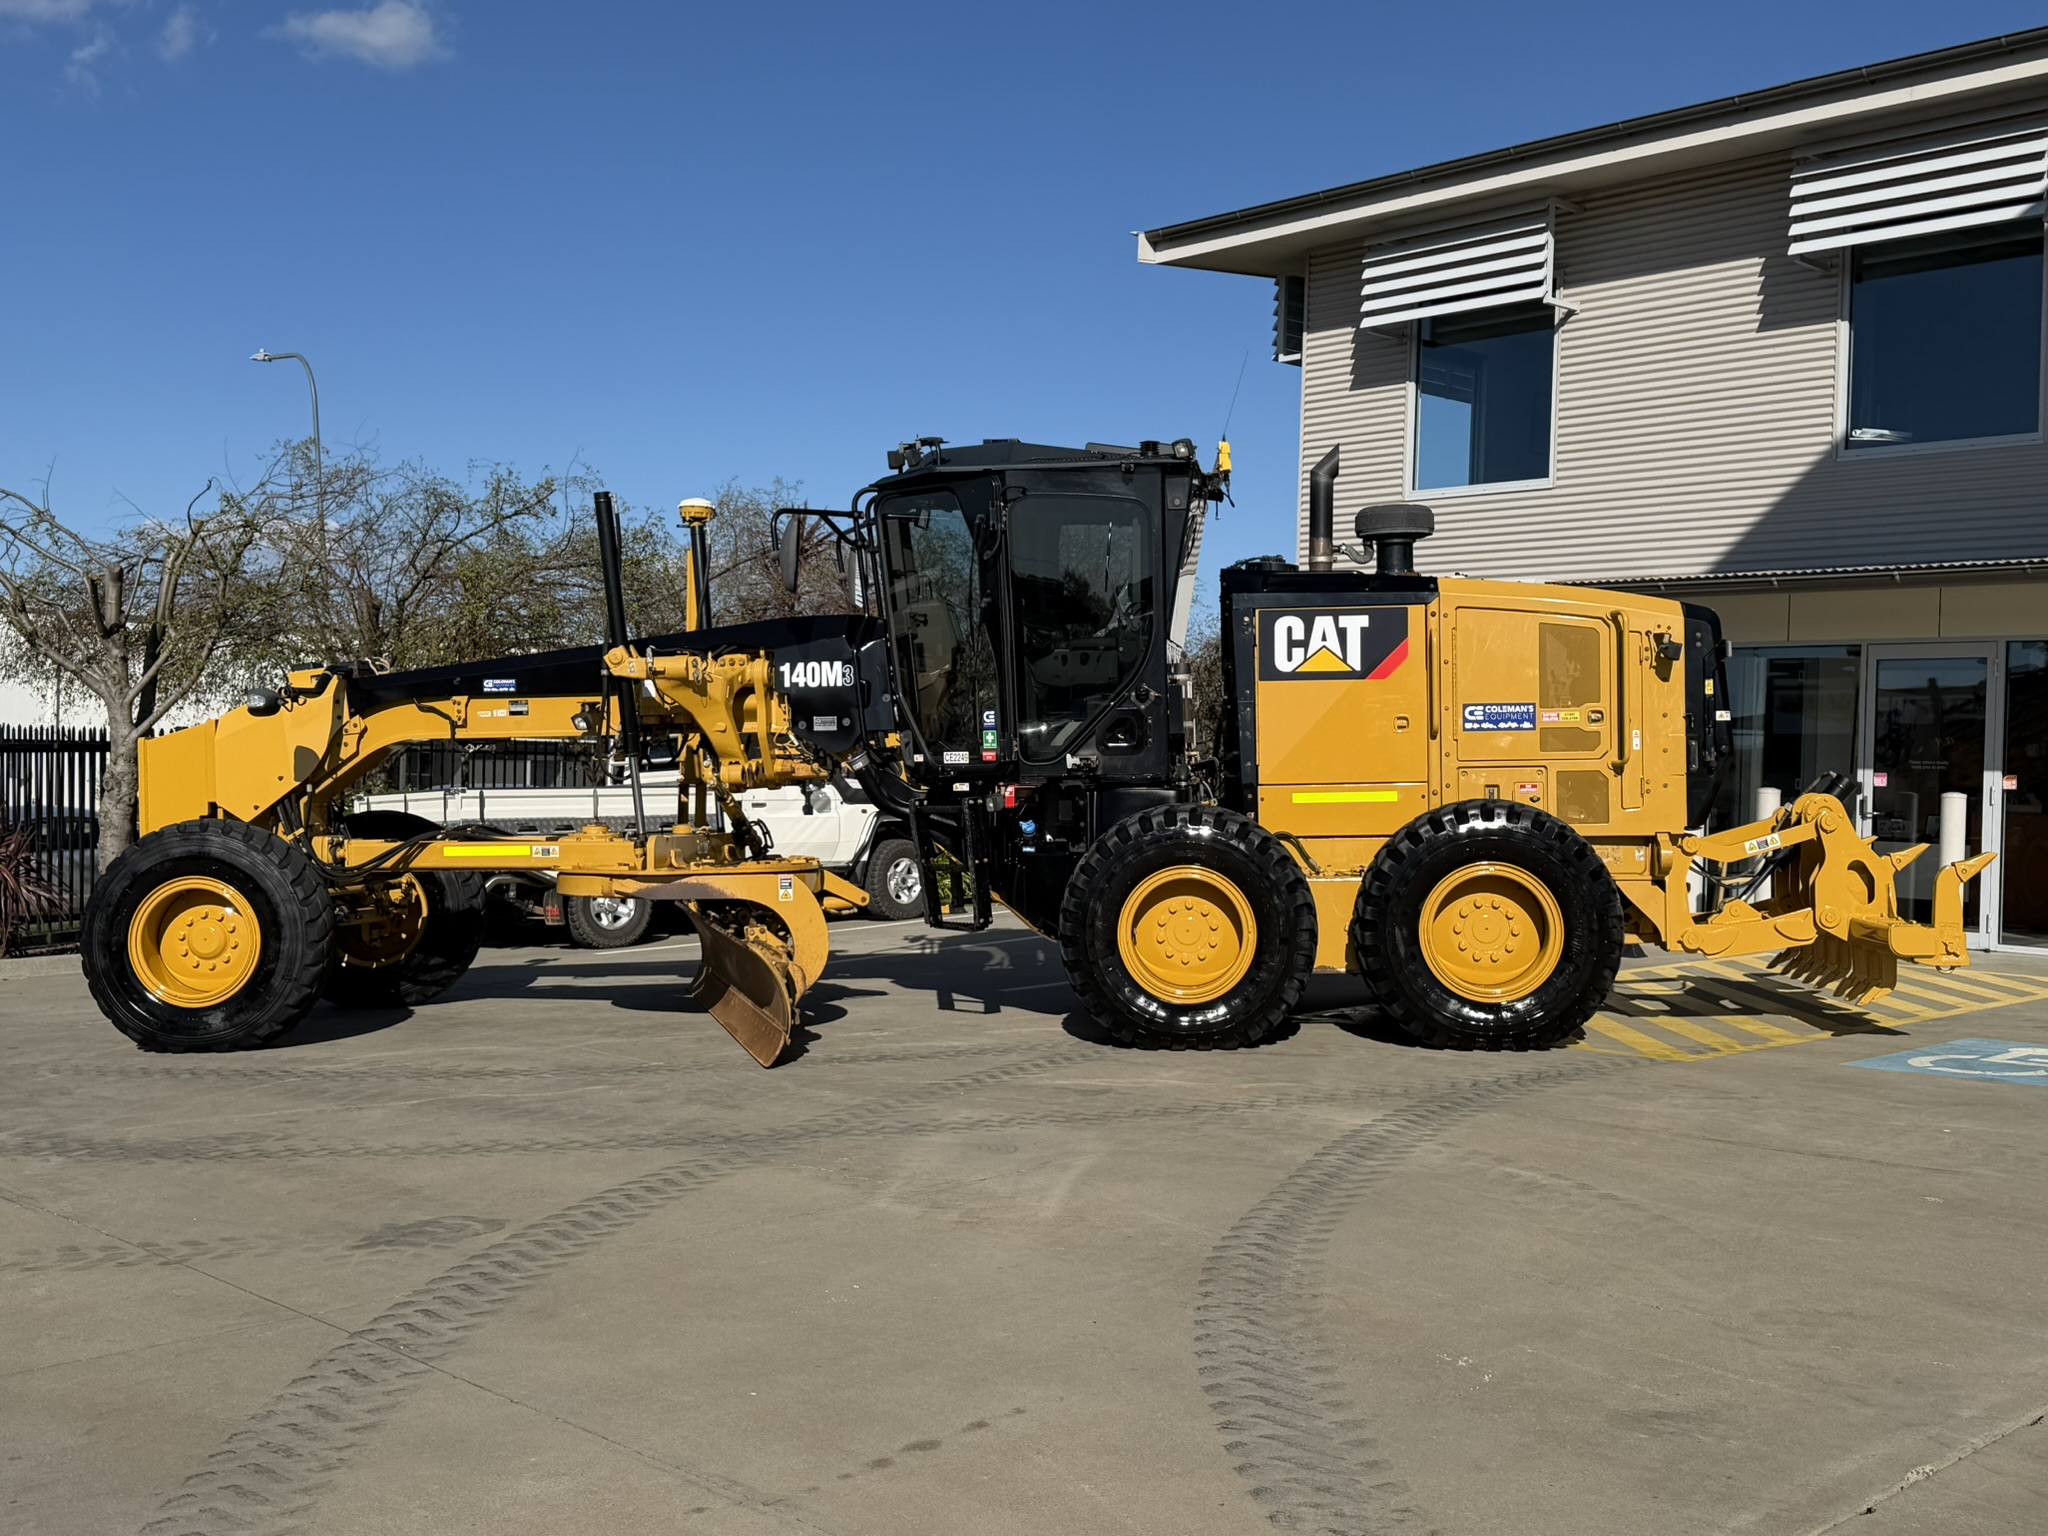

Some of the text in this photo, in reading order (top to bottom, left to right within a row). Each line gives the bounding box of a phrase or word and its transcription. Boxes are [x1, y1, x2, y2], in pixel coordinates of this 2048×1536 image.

[1274, 615, 1369, 672] CAT
[779, 661, 854, 687] 140M3
[1485, 705, 1534, 713] COLEMAN'S
